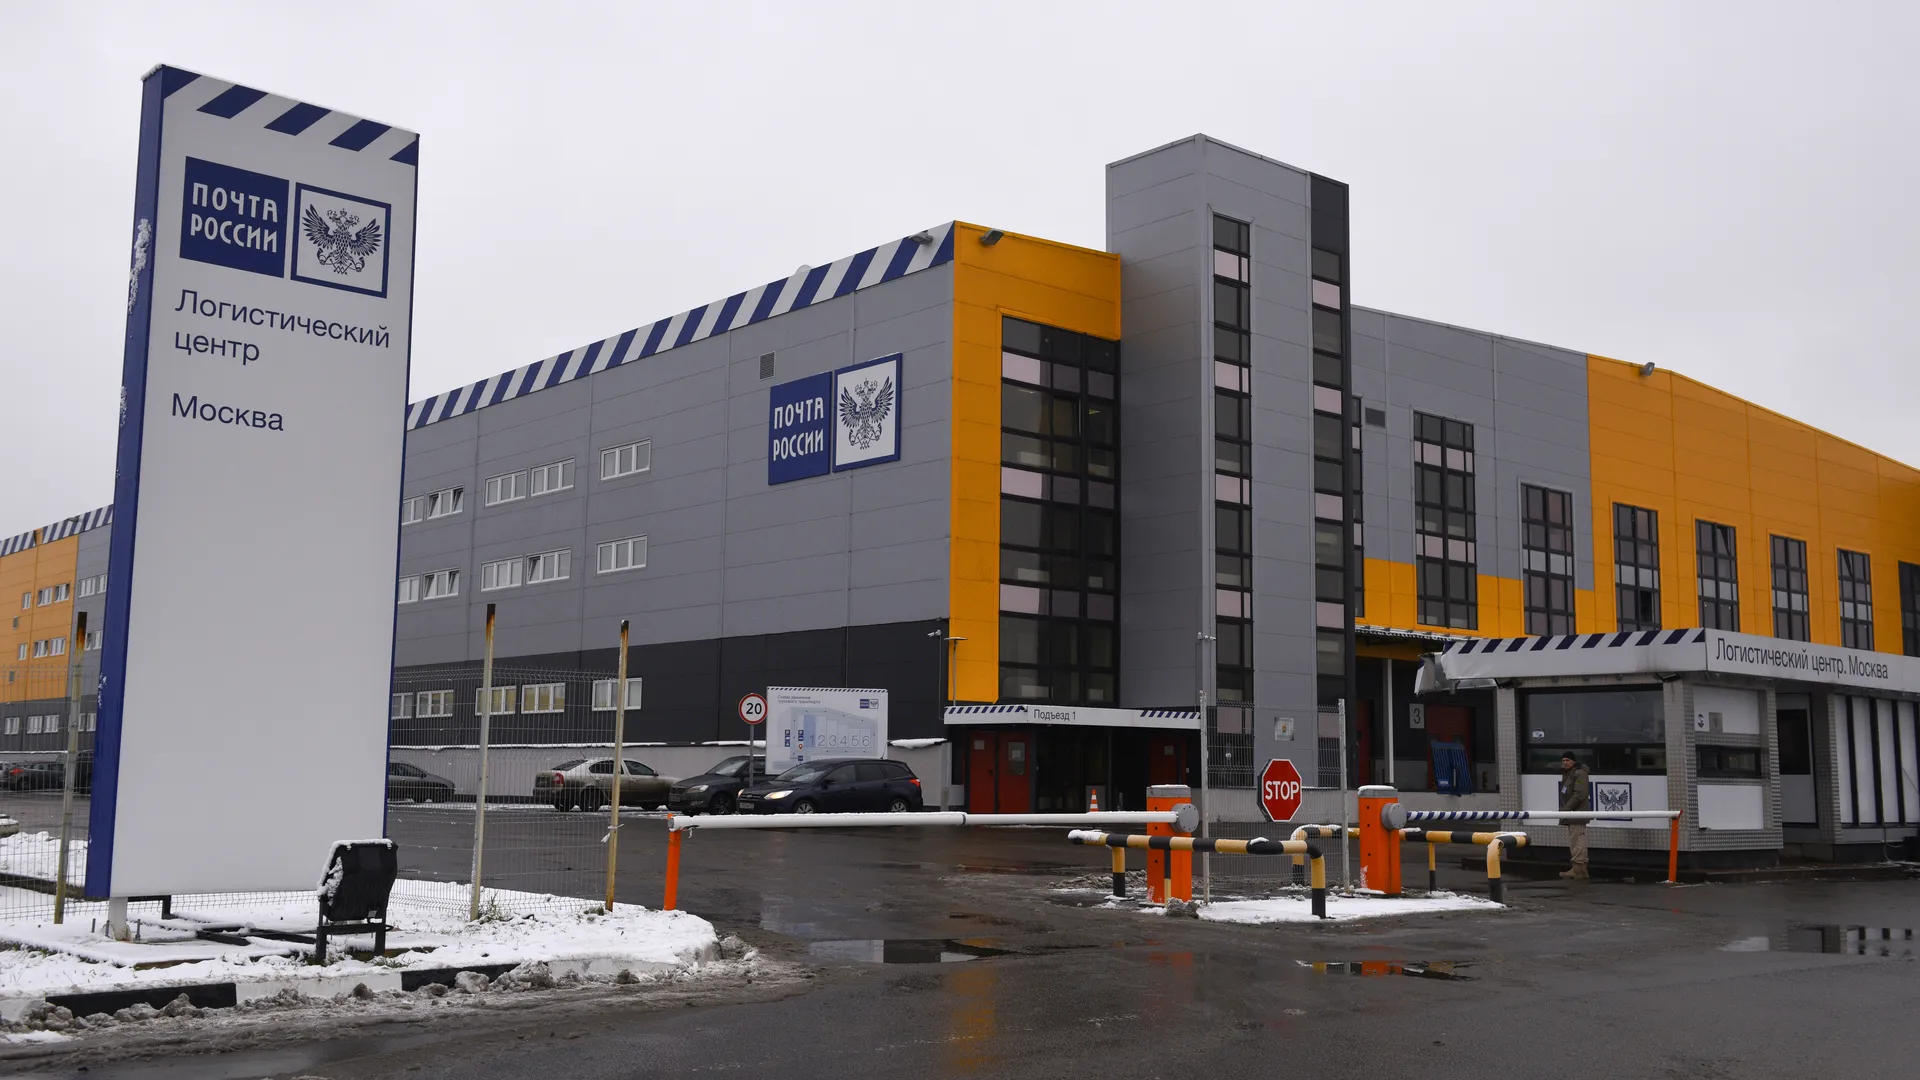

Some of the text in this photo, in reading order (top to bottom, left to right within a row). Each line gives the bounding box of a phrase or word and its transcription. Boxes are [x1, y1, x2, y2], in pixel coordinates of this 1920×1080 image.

[192, 182, 278, 222] ПОЧТА
[190, 213, 278, 254] РОССИИ
[175, 289, 390, 348] Логистический
[174, 332, 260, 365] центр
[172, 393, 284, 432] Москва
[774, 397, 824, 430] ПОЧТА
[773, 428, 824, 461] РОССИИ
[1716, 637, 1889, 680] Логистический центр. Москва
[745, 702, 762, 715] 20
[1033, 709, 1076, 723] Подъезд 1
[1413, 708, 1421, 724] 3
[818, 735, 825, 746] 2
[829, 735, 836, 746] 3
[840, 736, 847, 746] 4
[851, 736, 859, 747] 5
[862, 736, 870, 747] 6
[1265, 780, 1299, 801] STOP
